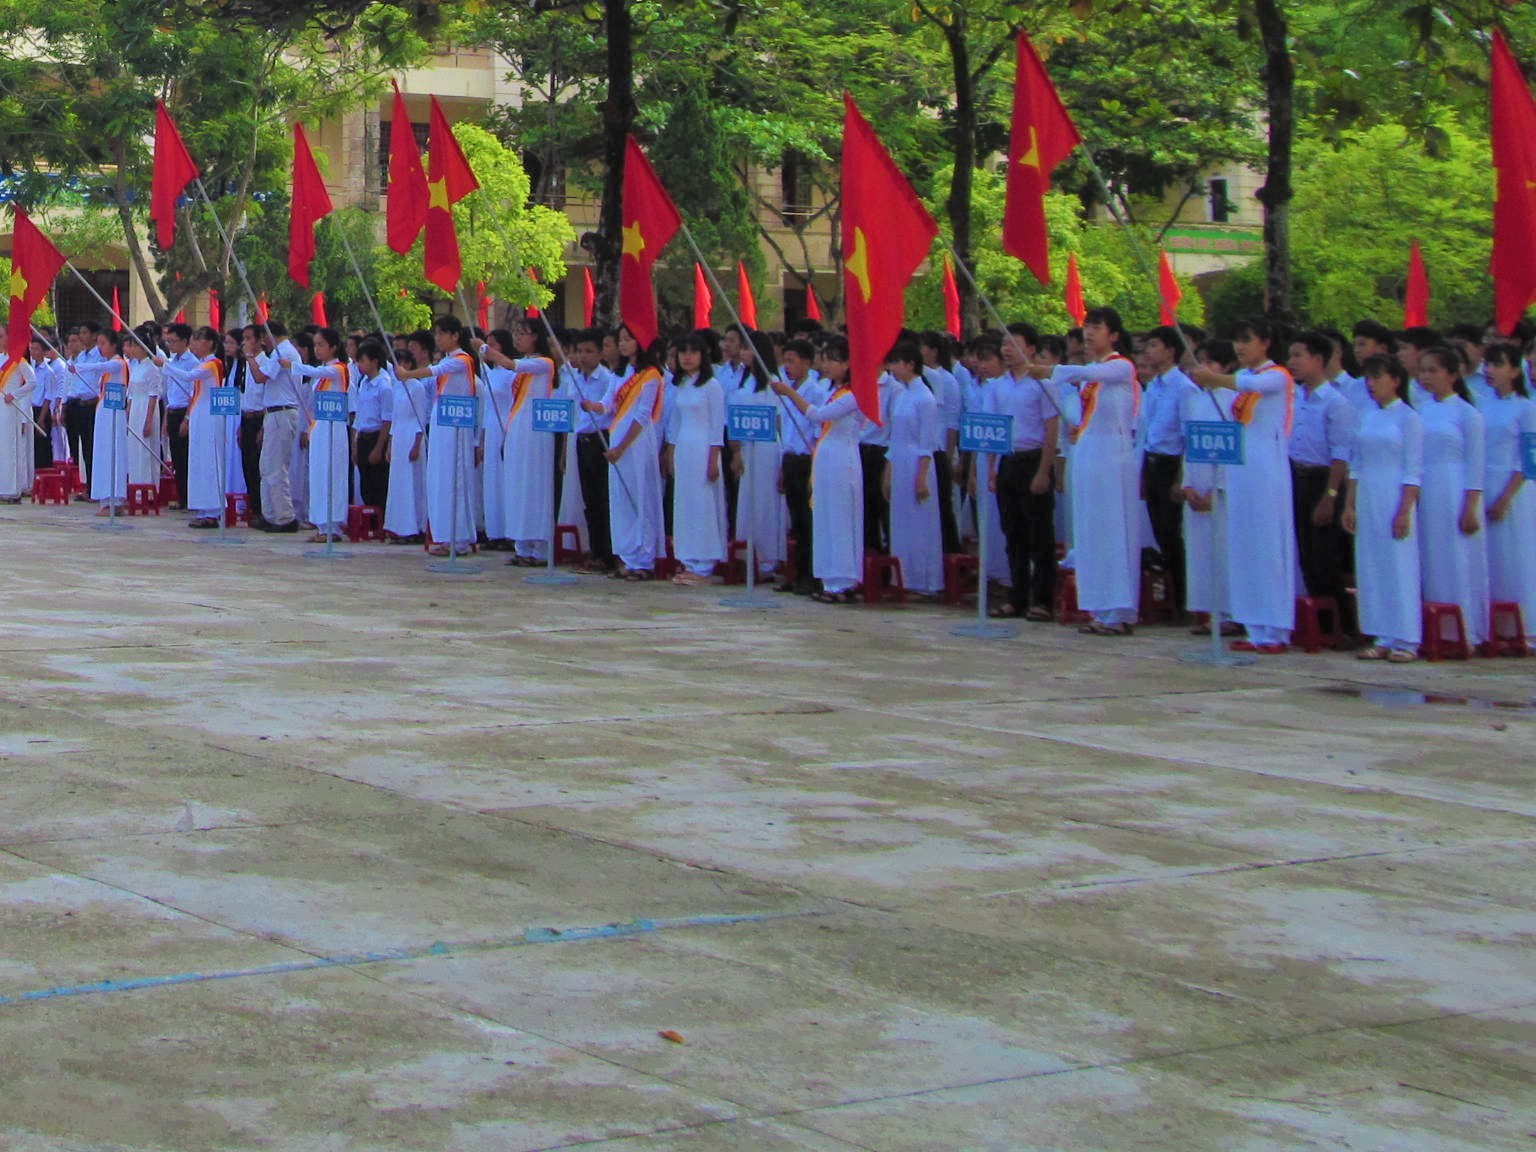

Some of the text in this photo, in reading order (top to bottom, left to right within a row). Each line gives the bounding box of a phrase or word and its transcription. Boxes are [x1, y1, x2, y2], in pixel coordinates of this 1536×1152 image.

[317, 400, 342, 413] 10B4
[440, 405, 473, 418] 10B3
[535, 409, 568, 422] 10B2
[732, 416, 770, 431] 10B1
[963, 424, 1007, 442] 10A2
[1190, 433, 1236, 451] 10A1
